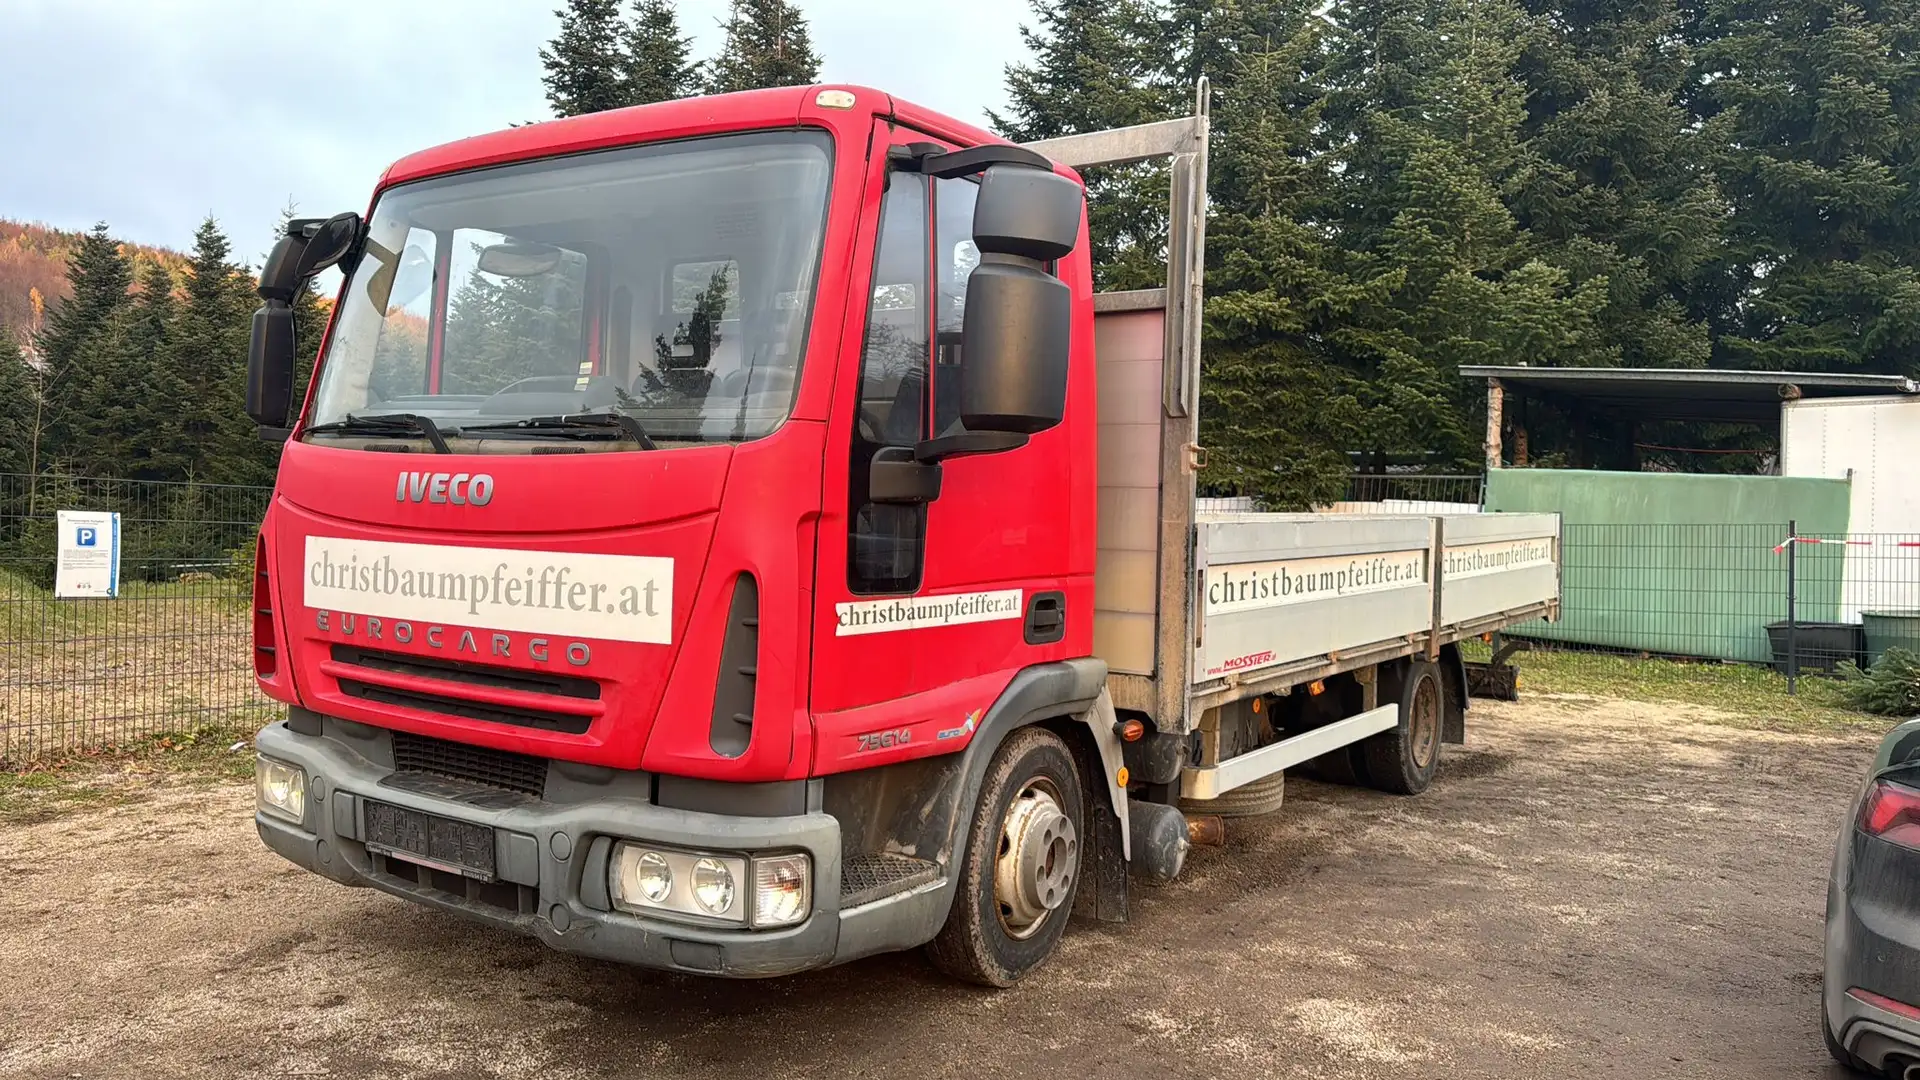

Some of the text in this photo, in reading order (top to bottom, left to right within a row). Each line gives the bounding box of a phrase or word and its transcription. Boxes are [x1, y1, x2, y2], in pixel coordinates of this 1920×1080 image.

[395, 472, 494, 506] IVECO
[81, 529, 92, 544] P
[310, 550, 659, 616] christbaumpfeiffer.at
[1209, 557, 1419, 604] christbaumpfeiffer.at
[839, 595, 1017, 626] christbaumpfeiffer.at
[316, 610, 591, 666] EUROCARGO
[858, 728, 911, 751] 75E14
